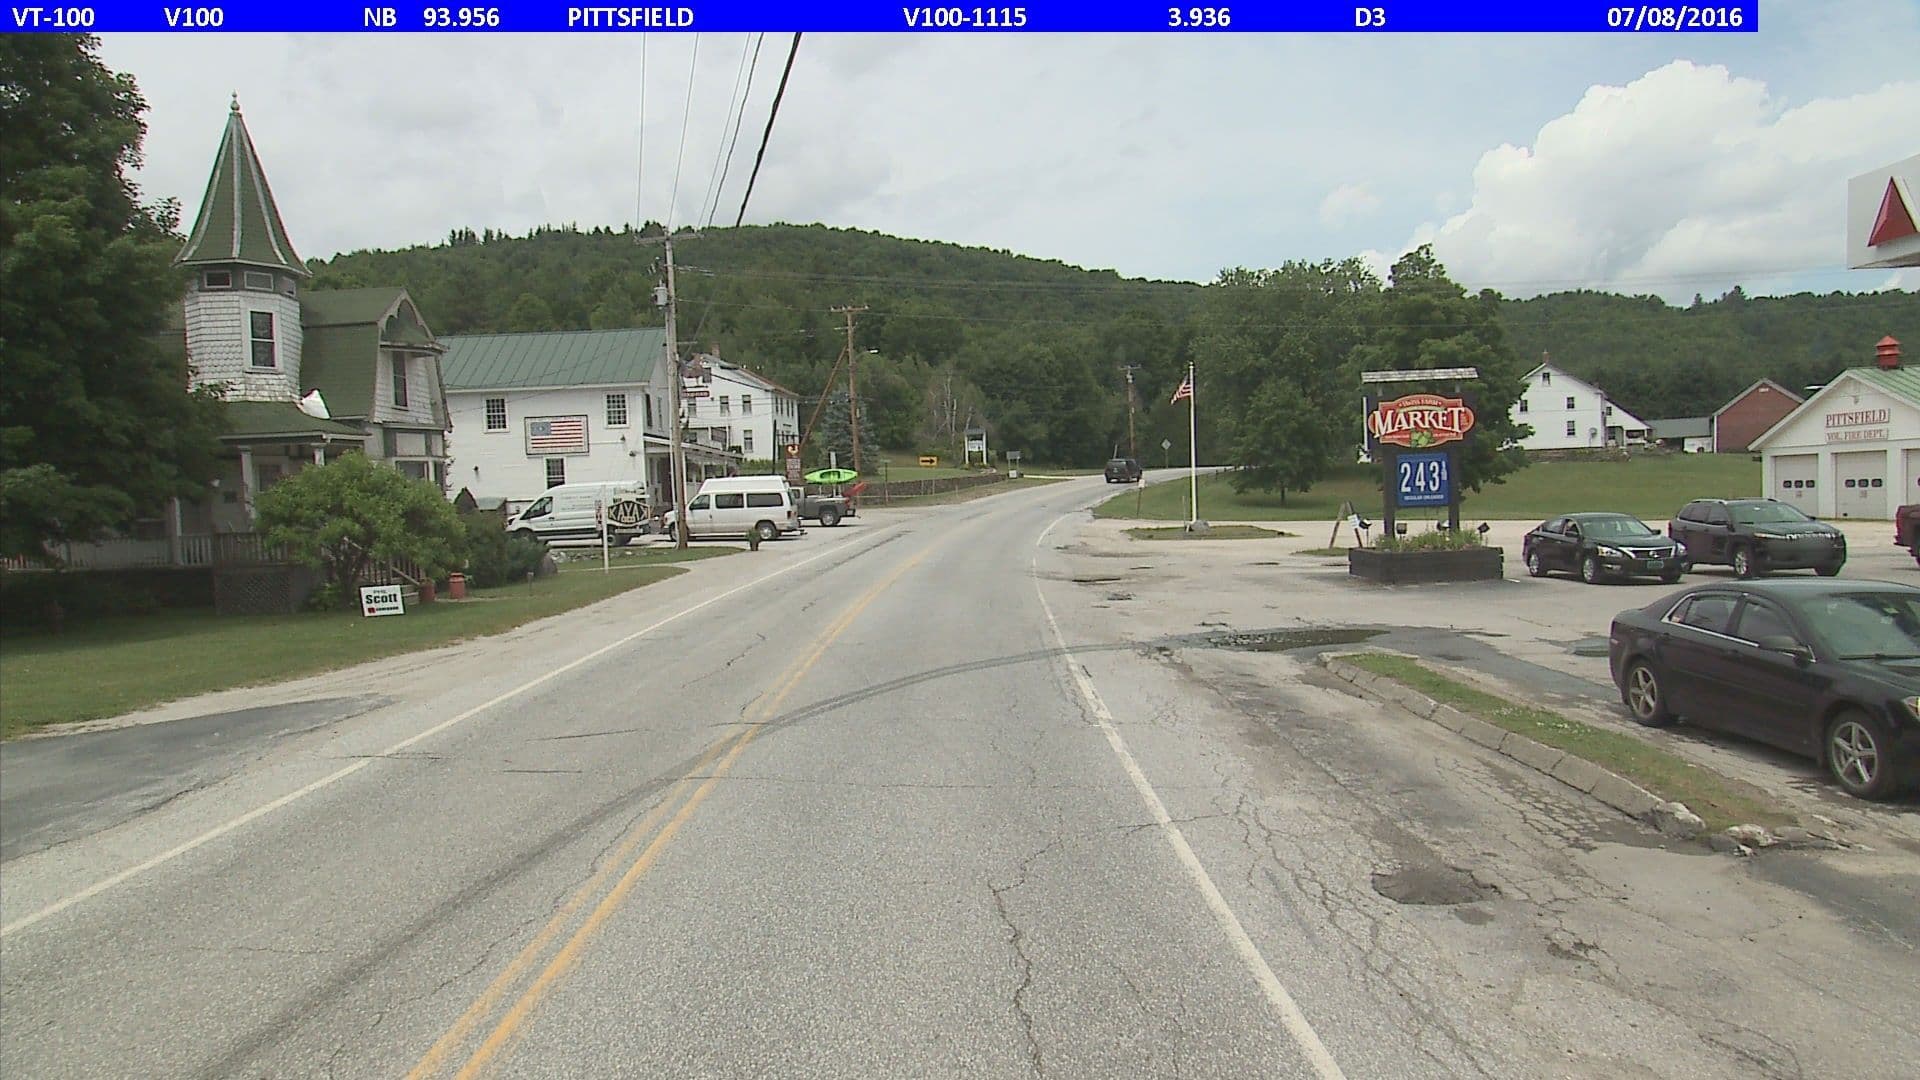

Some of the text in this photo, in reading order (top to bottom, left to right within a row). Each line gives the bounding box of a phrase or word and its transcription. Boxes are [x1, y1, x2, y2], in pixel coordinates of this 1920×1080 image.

[1373, 407, 1465, 438] MARKET
[1826, 409, 1887, 426] PITTSFIELD
[1844, 430, 1861, 440] FIRE
[608, 502, 648, 521] KAYAK
[365, 594, 398, 604] Scott
